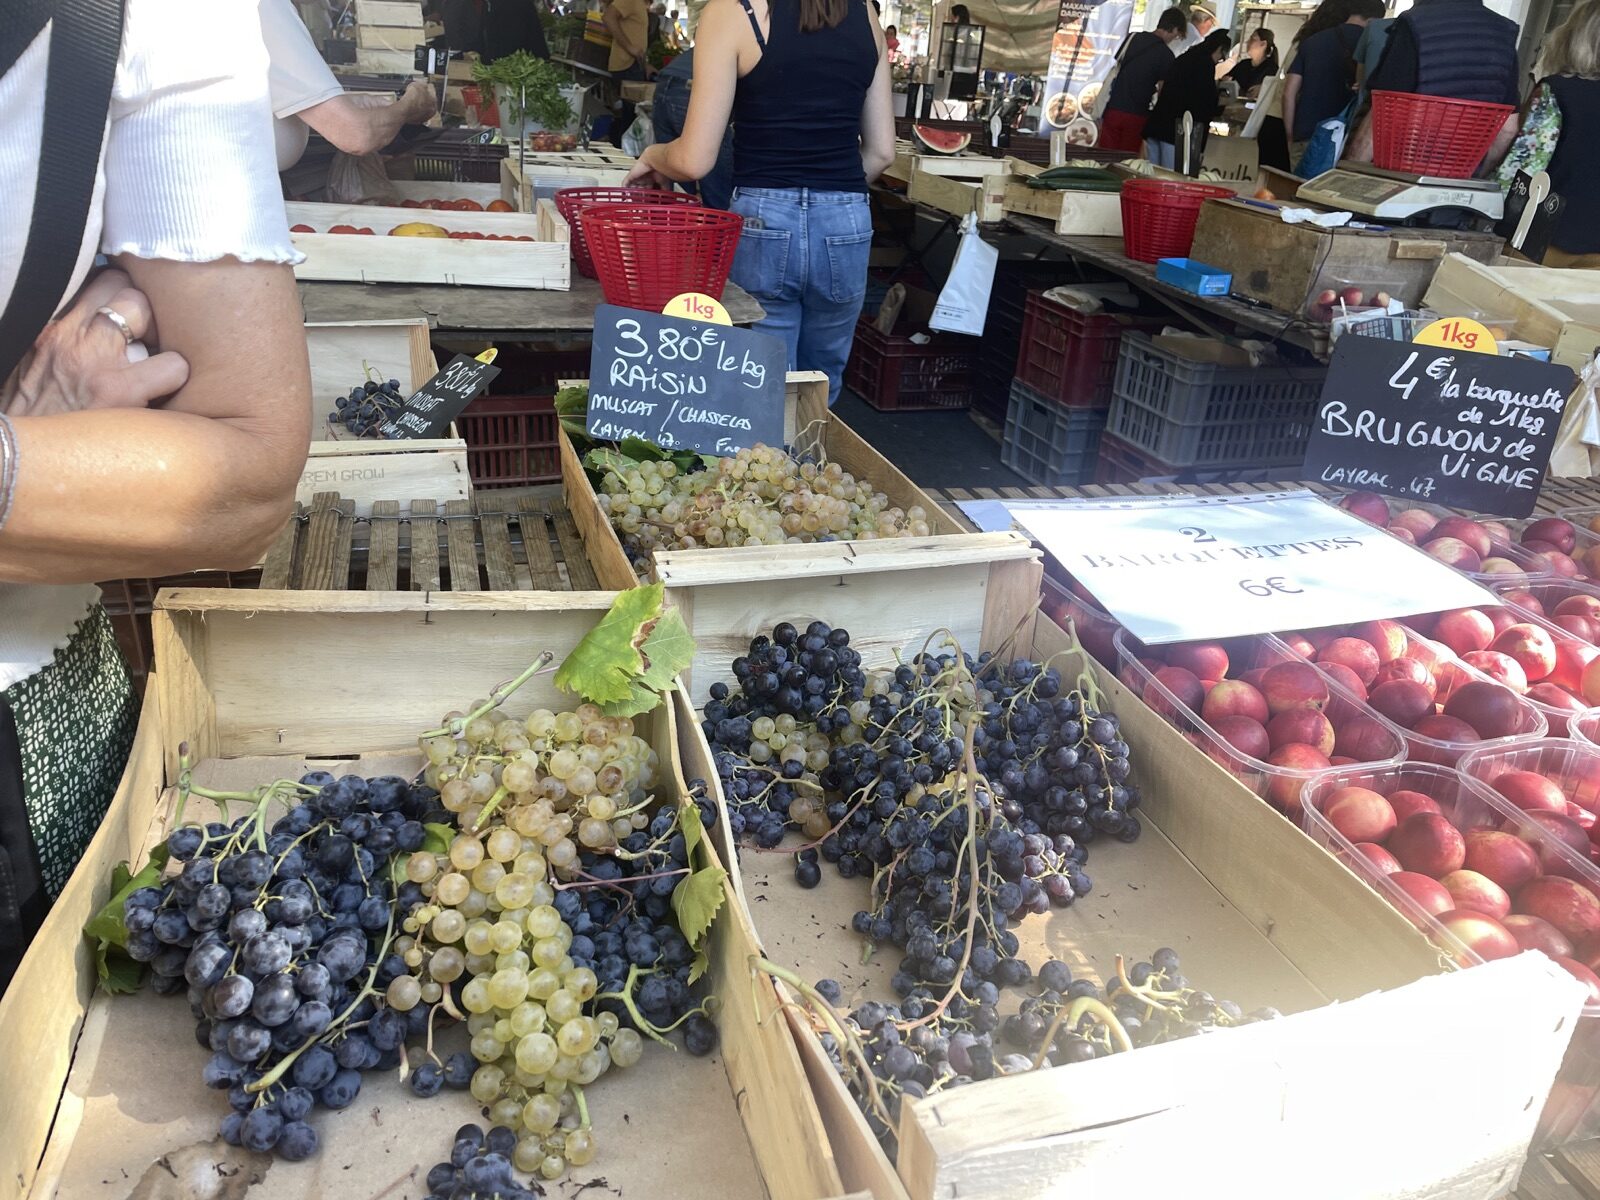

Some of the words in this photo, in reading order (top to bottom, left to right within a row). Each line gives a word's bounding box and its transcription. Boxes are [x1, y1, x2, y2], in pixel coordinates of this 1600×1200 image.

[1511, 176, 1527, 196] 3,90
[683, 296, 715, 319] 1kg
[1441, 322, 1479, 349] 1kg
[716, 340, 738, 372] le
[741, 349, 766, 389] kg
[590, 393, 658, 417] MUSCAT
[1465, 377, 1565, 415] barquette
[1457, 406, 1485, 425] de
[1320, 400, 1502, 455] BRUGNON
[1503, 438, 1537, 462] de
[341, 467, 385, 482] GROW
[1178, 526, 1217, 543] 2
[1081, 536, 1364, 569] BARQUETTES
[1238, 576, 1304, 597] 6€
